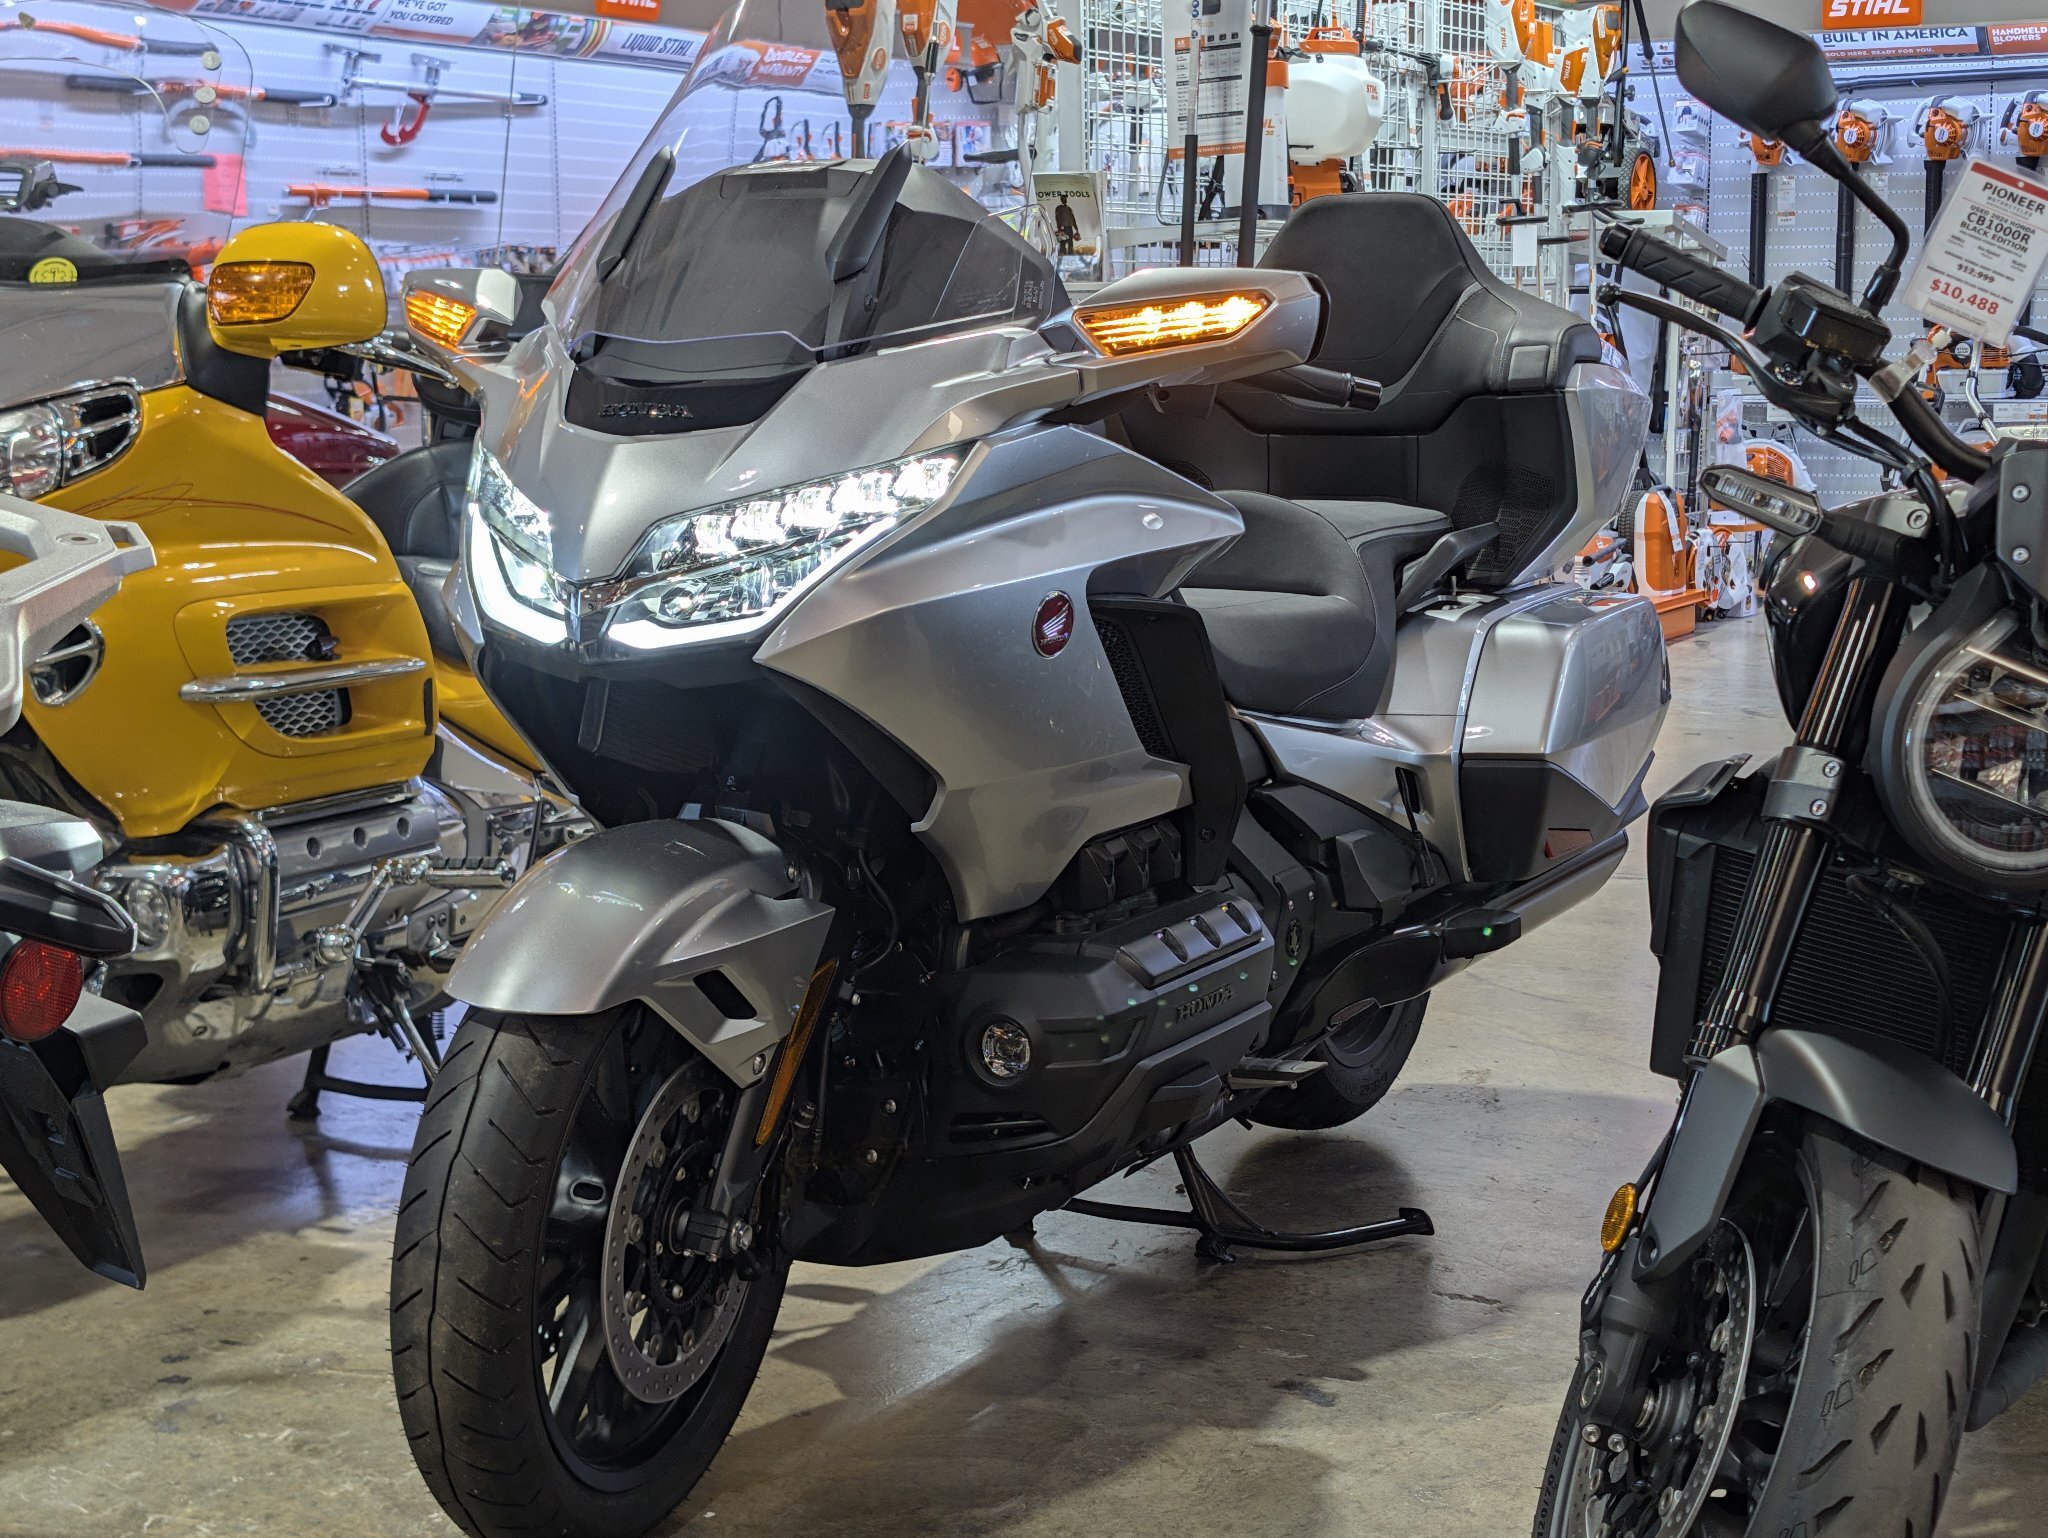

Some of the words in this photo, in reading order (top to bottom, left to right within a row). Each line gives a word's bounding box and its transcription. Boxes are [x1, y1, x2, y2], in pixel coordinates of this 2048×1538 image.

[426, 3, 447, 12] GOT
[1829, 0, 1910, 17] STIHL
[389, 11, 409, 21] YOU
[409, 13, 454, 26] COVERED
[1823, 31, 1868, 43] BUILT
[1872, 30, 1890, 41] IN
[1893, 27, 1969, 40] AMERICA
[1992, 26, 2048, 36] HANDHELD
[1993, 34, 2042, 43] BLOWERS
[621, 32, 661, 53] LIQUID
[658, 37, 695, 57] STIHL
[1982, 182, 2045, 215] PIONEER
[1967, 212, 2031, 246] CB1000R
[1970, 205, 1990, 217] USED
[1991, 212, 2009, 225] 2024
[2010, 220, 2036, 235] HONDA
[1960, 221, 1989, 237] BLACK
[1991, 233, 2029, 253] EDITION
[1957, 263, 1995, 284] $12,999
[1930, 278, 1999, 315] $10,488
[599, 402, 694, 419] HONDA
[1176, 984, 1236, 1022] HONDA
